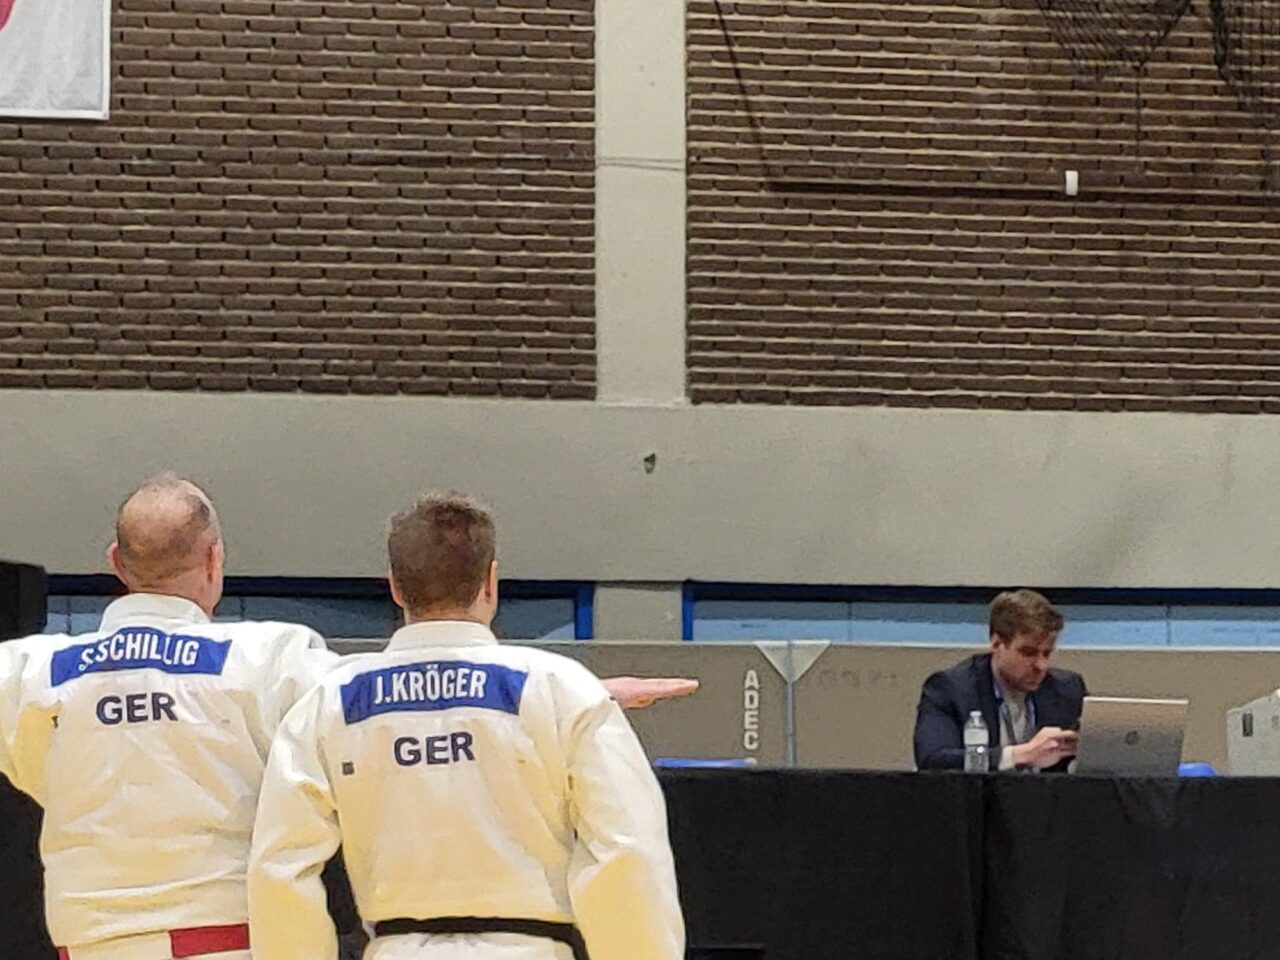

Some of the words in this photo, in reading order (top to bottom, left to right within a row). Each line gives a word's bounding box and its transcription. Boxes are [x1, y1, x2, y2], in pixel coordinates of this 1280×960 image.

[374, 663, 487, 705] J.KRÖGER
[95, 691, 179, 726] GER
[743, 669, 760, 765] ADEC
[393, 731, 476, 767] GER
